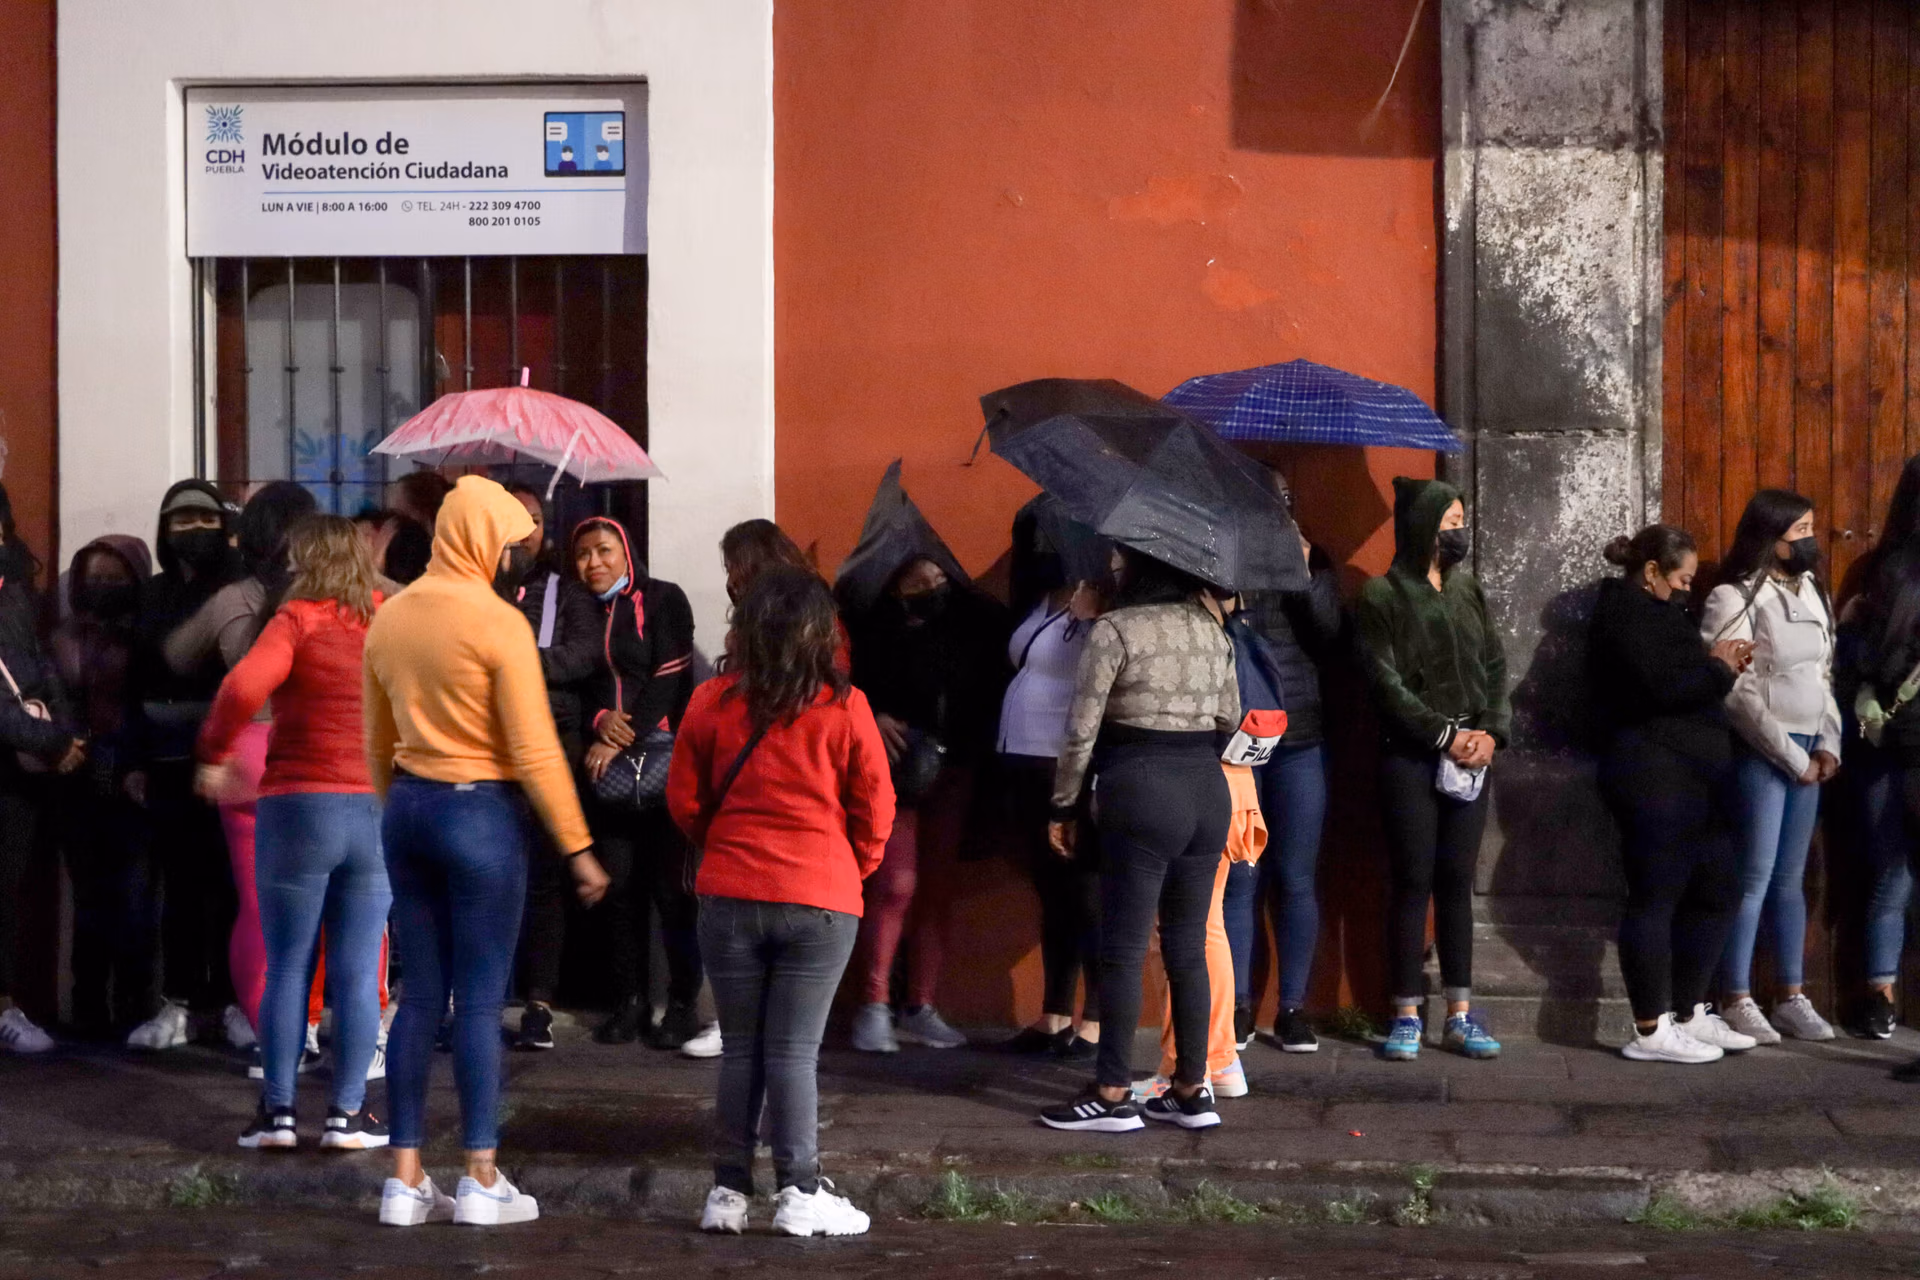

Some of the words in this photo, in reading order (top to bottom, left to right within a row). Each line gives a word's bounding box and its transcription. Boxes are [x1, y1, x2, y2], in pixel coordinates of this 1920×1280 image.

[262, 131, 368, 157] Módulo
[375, 130, 410, 156] de
[205, 149, 245, 164] CDH
[205, 165, 245, 174] PUEBLA
[261, 162, 400, 181] Videoatención
[404, 160, 509, 180] Ciudadana
[261, 202, 284, 212] LUN
[286, 202, 295, 212] A
[296, 202, 314, 212] VIE
[322, 201, 346, 212] 8:00
[347, 202, 356, 212] A
[358, 201, 389, 212] 16:00
[439, 201, 460, 211] 24H
[468, 201, 489, 211] 222
[491, 201, 512, 211] 309
[513, 200, 542, 211] 4700
[468, 216, 490, 227] 800
[491, 216, 511, 227] 201
[513, 216, 542, 227] 0105
